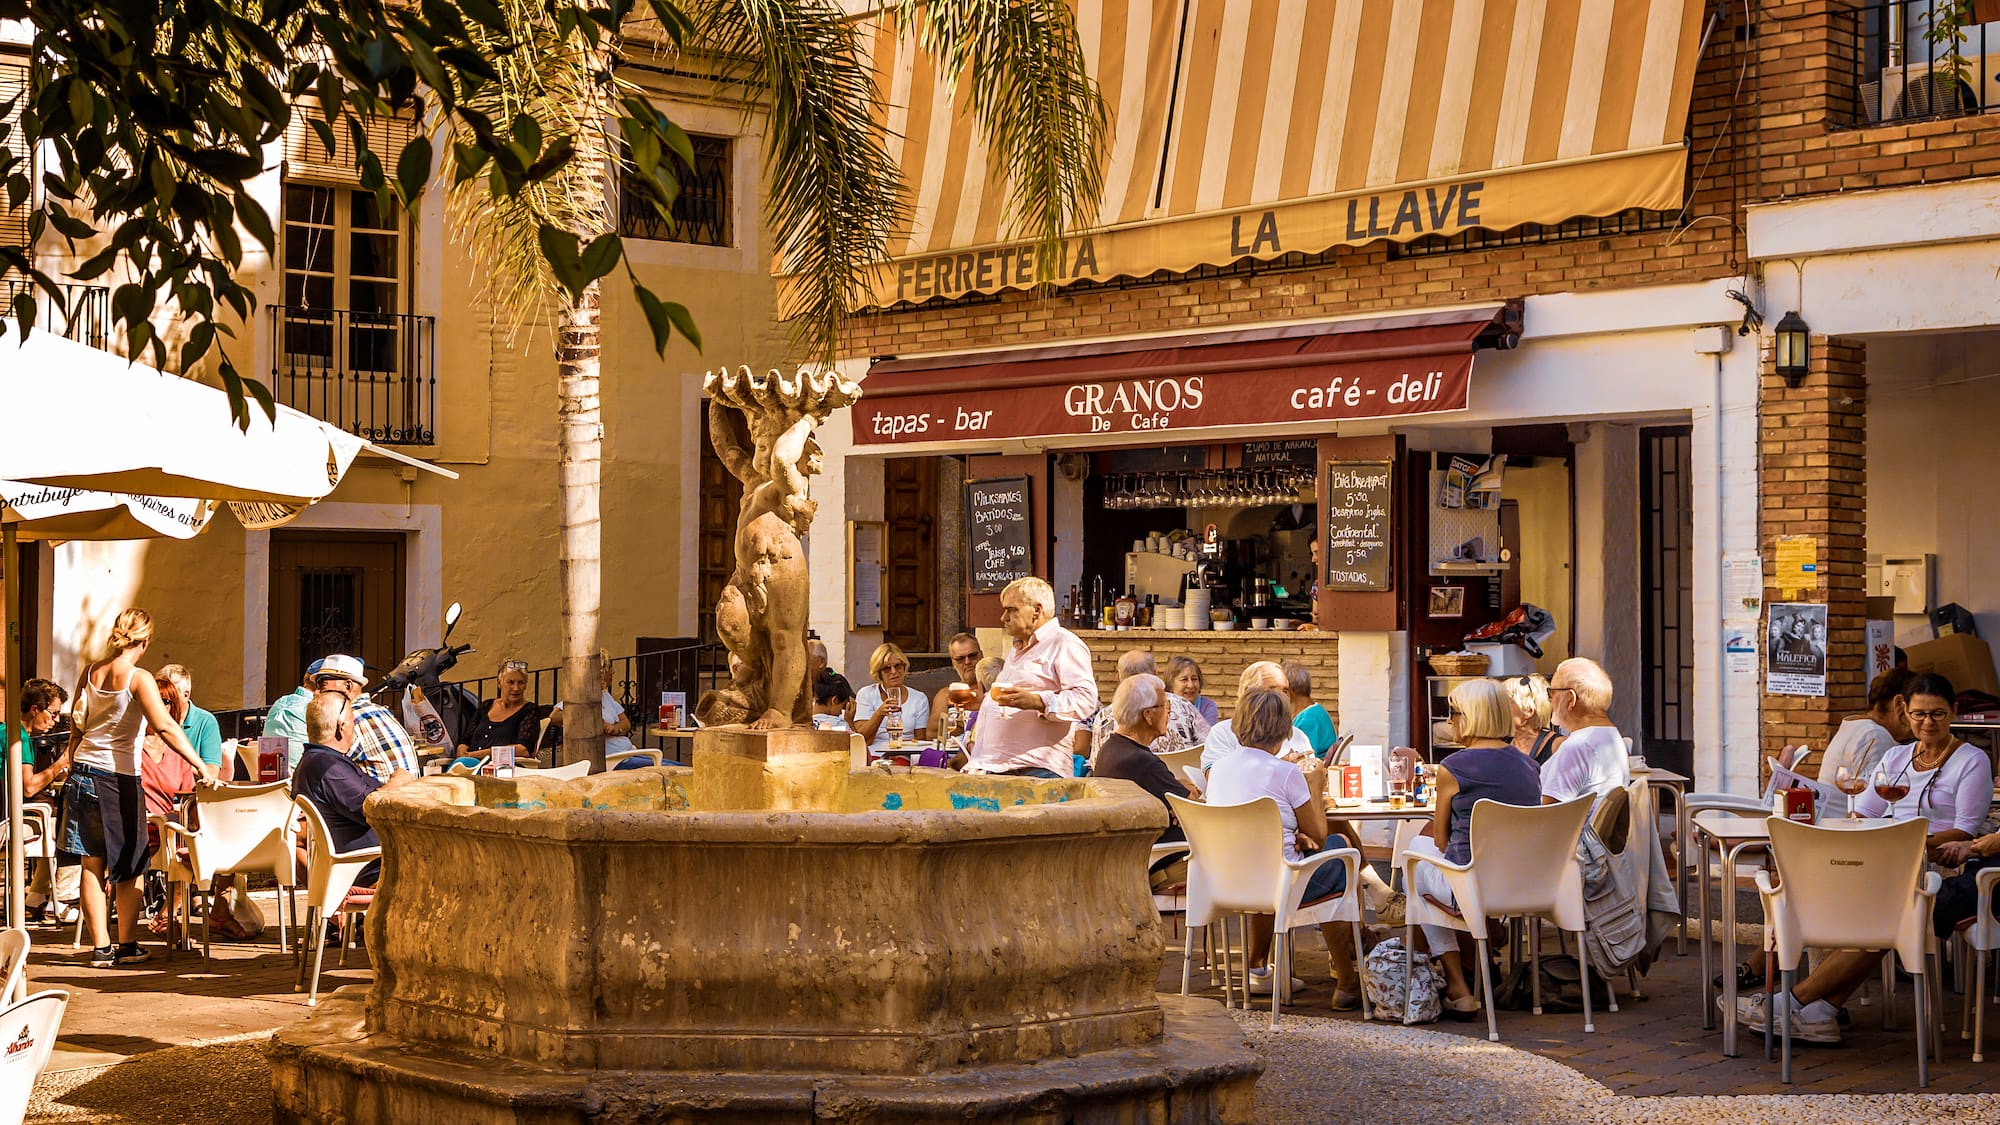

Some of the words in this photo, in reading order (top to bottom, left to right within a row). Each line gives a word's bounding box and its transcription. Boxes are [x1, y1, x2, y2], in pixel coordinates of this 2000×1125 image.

[1231, 211, 1281, 257] LA
[1346, 181, 1485, 241] LLAVE
[1064, 376, 1204, 416] GRANOS
[1387, 371, 1443, 404] deli
[871, 411, 930, 440] tapas
[954, 406, 993, 430] bar
[1090, 415, 1112, 432] De
[1131, 412, 1170, 429] Café
[1245, 442, 1270, 453] ZUMO
[1273, 441, 1282, 450] DE
[1255, 451, 1294, 462] NATURAL
[1331, 570, 1368, 584] TOSTADAS
